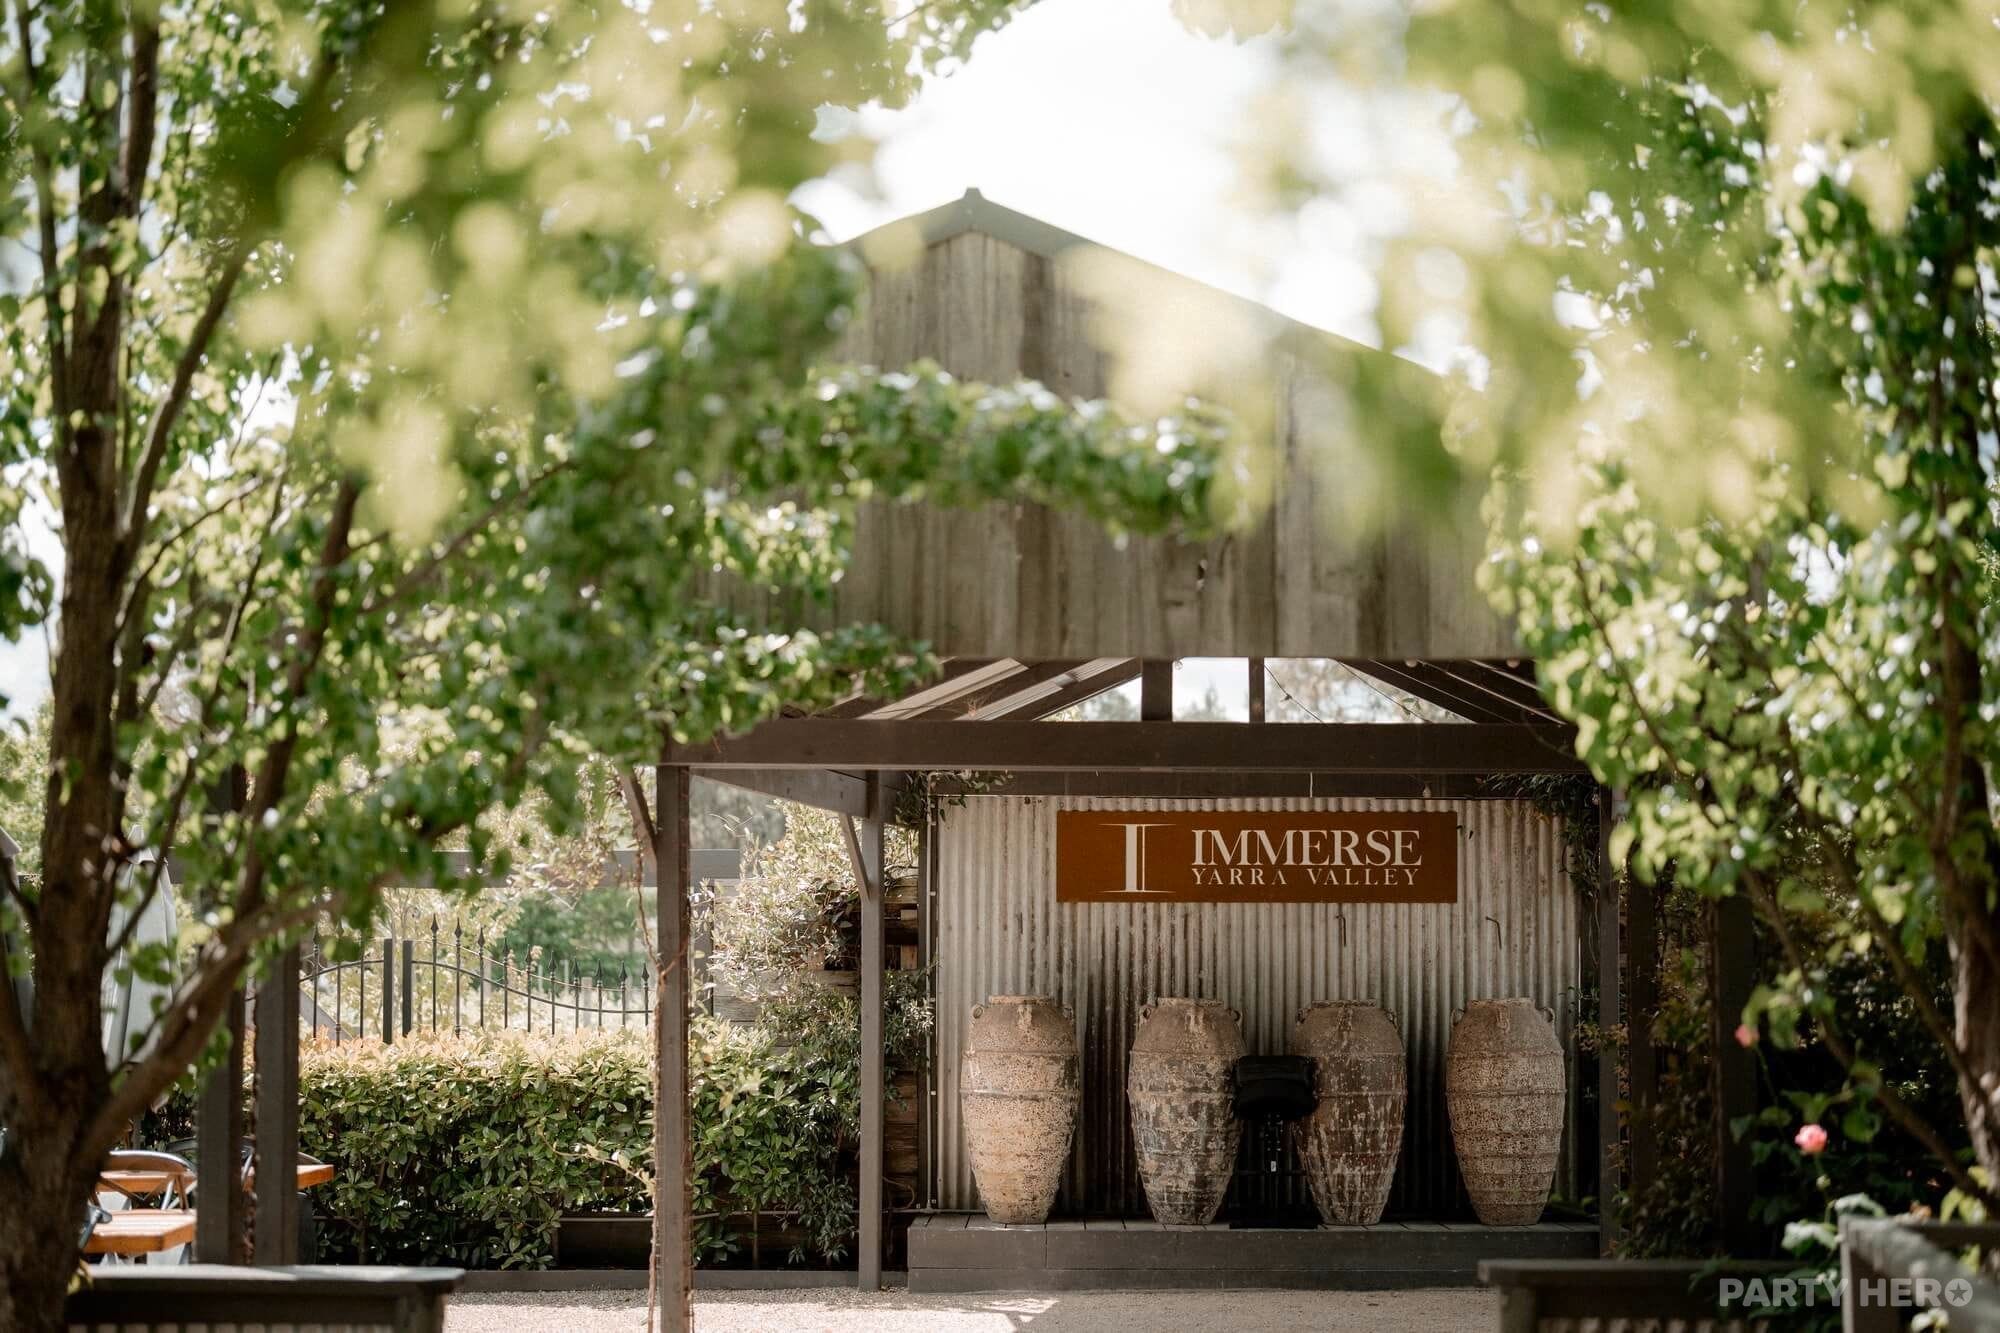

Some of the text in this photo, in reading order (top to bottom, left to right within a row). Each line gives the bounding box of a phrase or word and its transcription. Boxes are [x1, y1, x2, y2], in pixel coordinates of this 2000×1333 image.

[1192, 829, 1422, 866] IMMERSE
[1192, 868, 1420, 885] YARRA VALLEY
